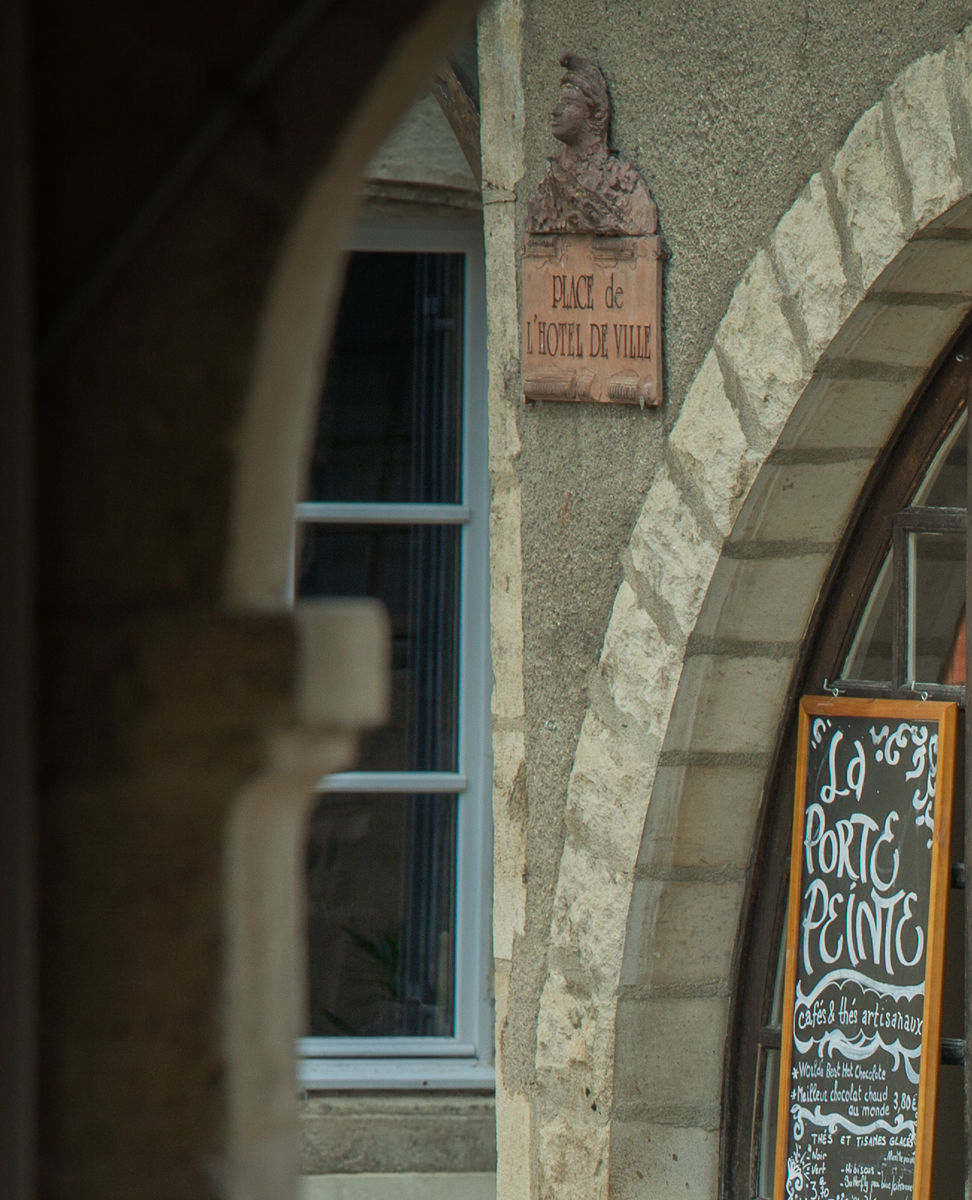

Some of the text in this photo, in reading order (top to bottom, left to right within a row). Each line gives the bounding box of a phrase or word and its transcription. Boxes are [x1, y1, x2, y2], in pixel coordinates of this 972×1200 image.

[552, 272, 624, 310] PLACE de
[526, 314, 652, 360] L'HOTEL DE VILLE
[820, 730, 866, 804] La
[804, 802, 899, 891] PORTE
[798, 996, 923, 1035] cafés & thés artisanaux
[830, 1080, 861, 1103] chocolat
[864, 1085, 888, 1103] chaud
[848, 1103, 890, 1117] au monde
[840, 1135, 851, 1146] ET
[811, 1161, 826, 1174] Vert
